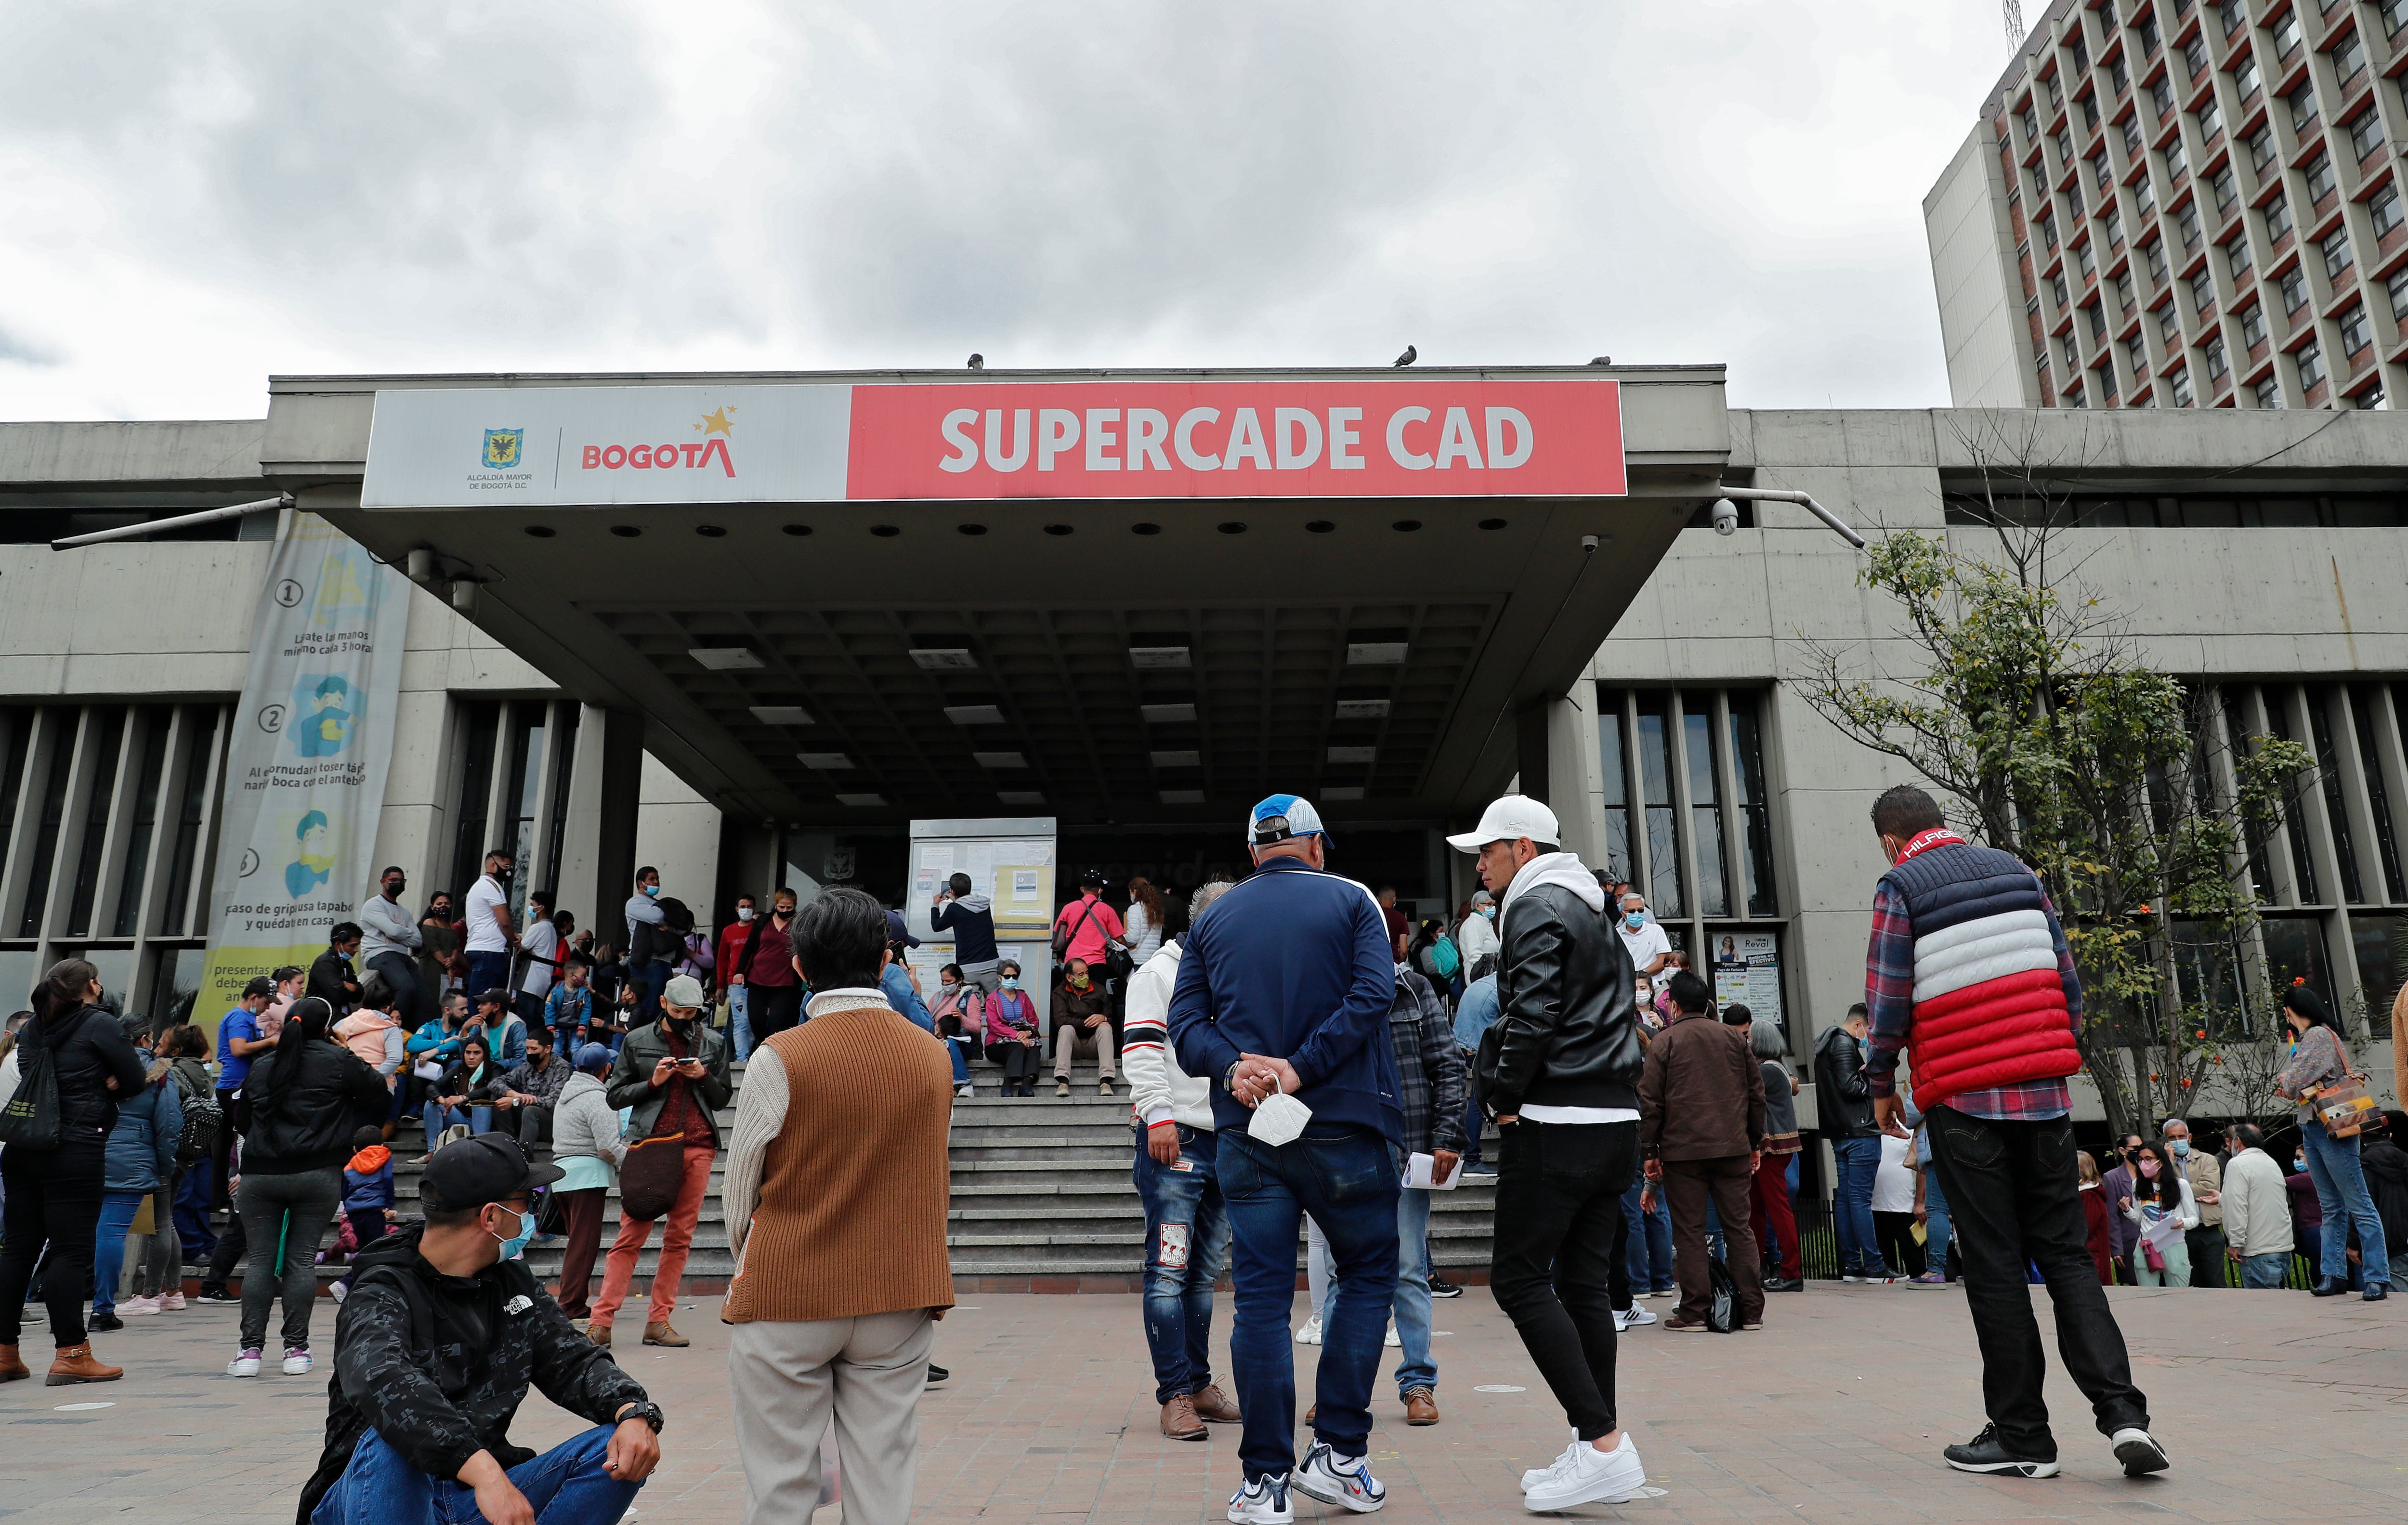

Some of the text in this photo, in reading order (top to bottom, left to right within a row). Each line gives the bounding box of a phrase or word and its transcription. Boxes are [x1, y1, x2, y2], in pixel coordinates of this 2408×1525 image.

[939, 405, 1534, 473] SUPERCADE CAD
[467, 473, 504, 481] ALCALDÍA
[481, 481, 513, 490] BOGOTÁ
[284, 585, 293, 602] 1
[338, 631, 368, 640] manos
[341, 642, 347, 652] 3
[269, 710, 279, 727] 2
[249, 767, 261, 777] Al
[320, 763, 344, 771] toser
[273, 776, 300, 787] boca
[318, 775, 327, 784] el
[1904, 829, 1962, 859] HILFIGE
[256, 903, 270, 913] de
[298, 903, 314, 912] usa
[245, 920, 253, 931] y
[298, 918, 309, 926] en
[312, 917, 335, 925] casa
[1745, 938, 1769, 948] Reval
[1749, 956, 1776, 965] EFECTIVO
[215, 965, 269, 977] presentas
